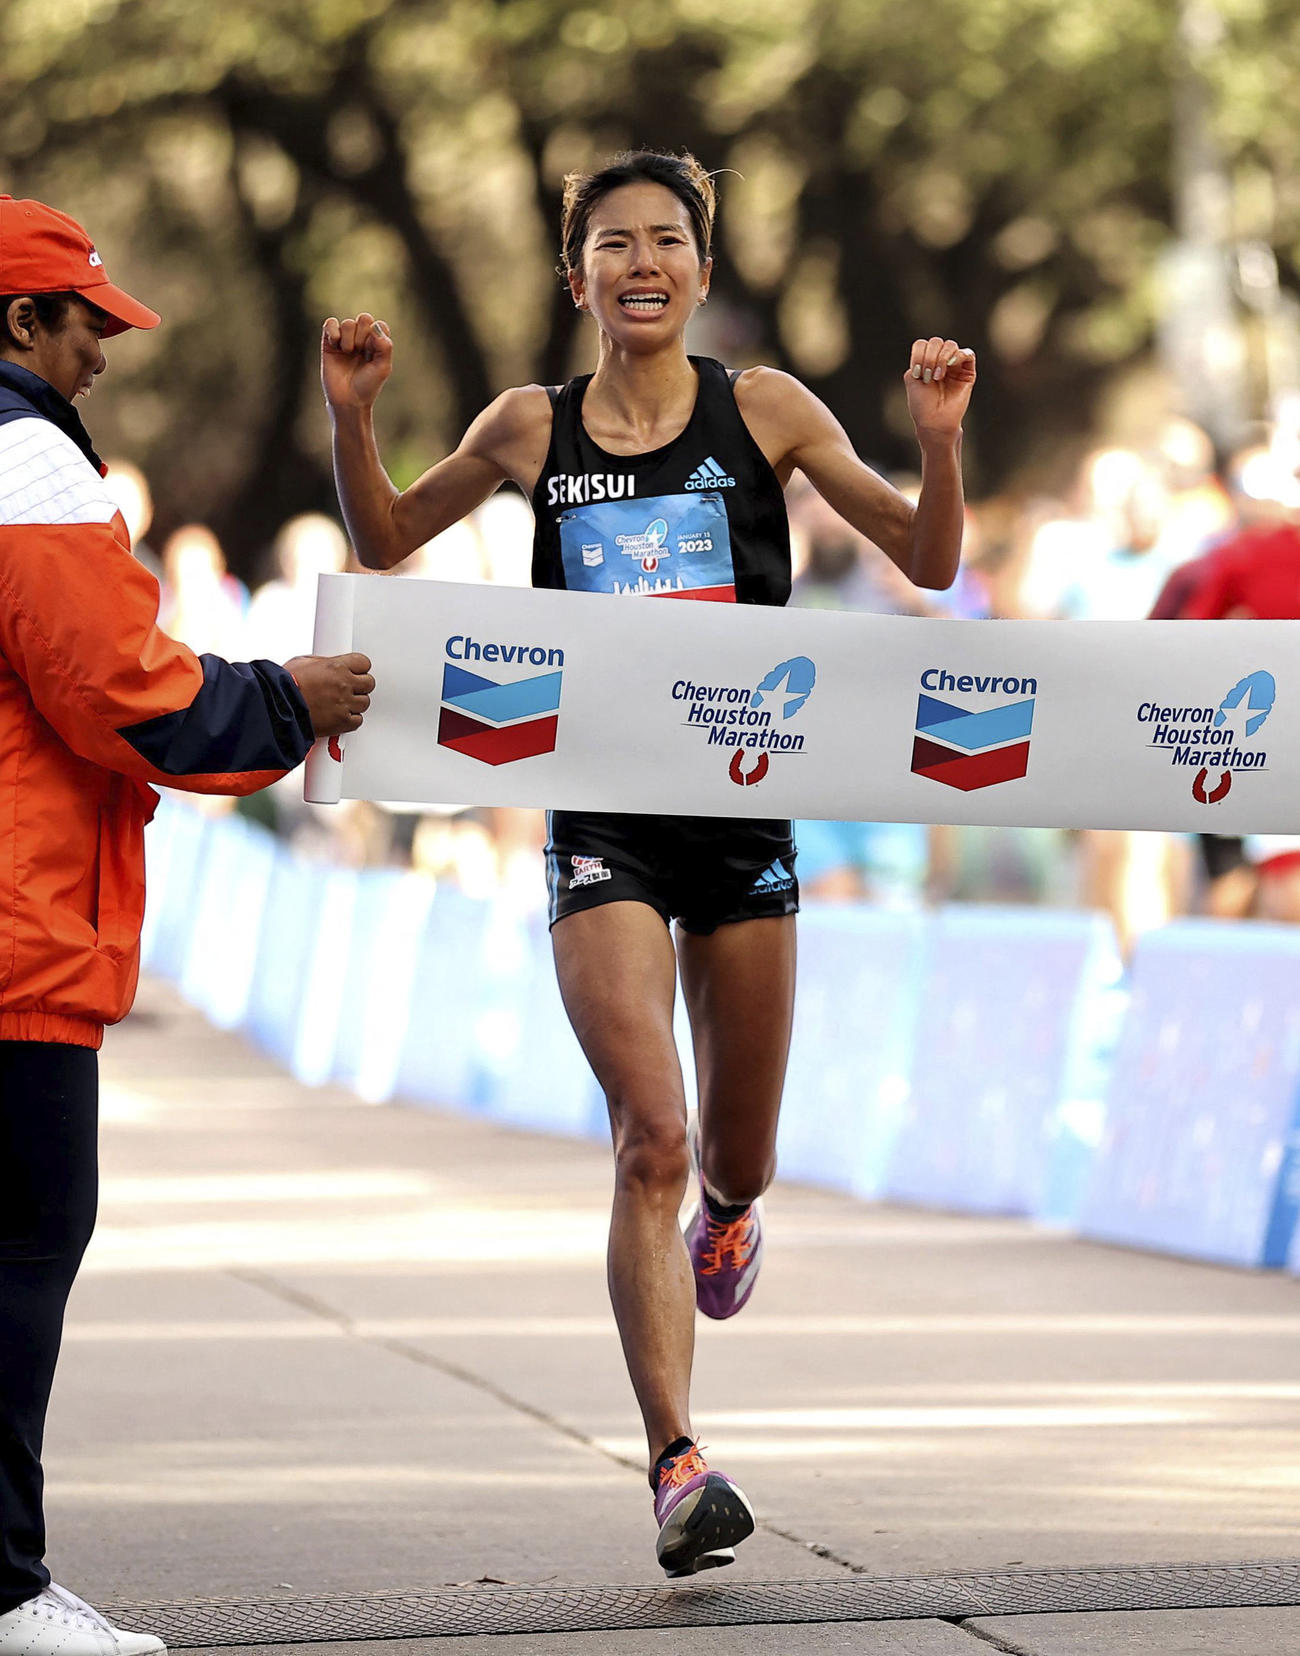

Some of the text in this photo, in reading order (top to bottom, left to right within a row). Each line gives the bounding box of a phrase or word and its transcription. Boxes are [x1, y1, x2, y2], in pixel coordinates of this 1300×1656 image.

[547, 474, 635, 506] SEKISUI
[684, 476, 736, 491] adidas
[616, 533, 646, 545] Chevron
[624, 541, 654, 551] Houston
[677, 538, 713, 554] 2023
[632, 547, 668, 559] Marathon
[445, 635, 564, 667] Chevron
[671, 679, 751, 704] Chevron
[920, 668, 1038, 694] Chevron
[687, 703, 772, 727] Houston
[1136, 702, 1215, 724] Chevron
[707, 725, 805, 751] Marathon
[1152, 724, 1235, 745] Houston
[1171, 745, 1267, 768] Marathon
[574, 863, 602, 877] EARTH
